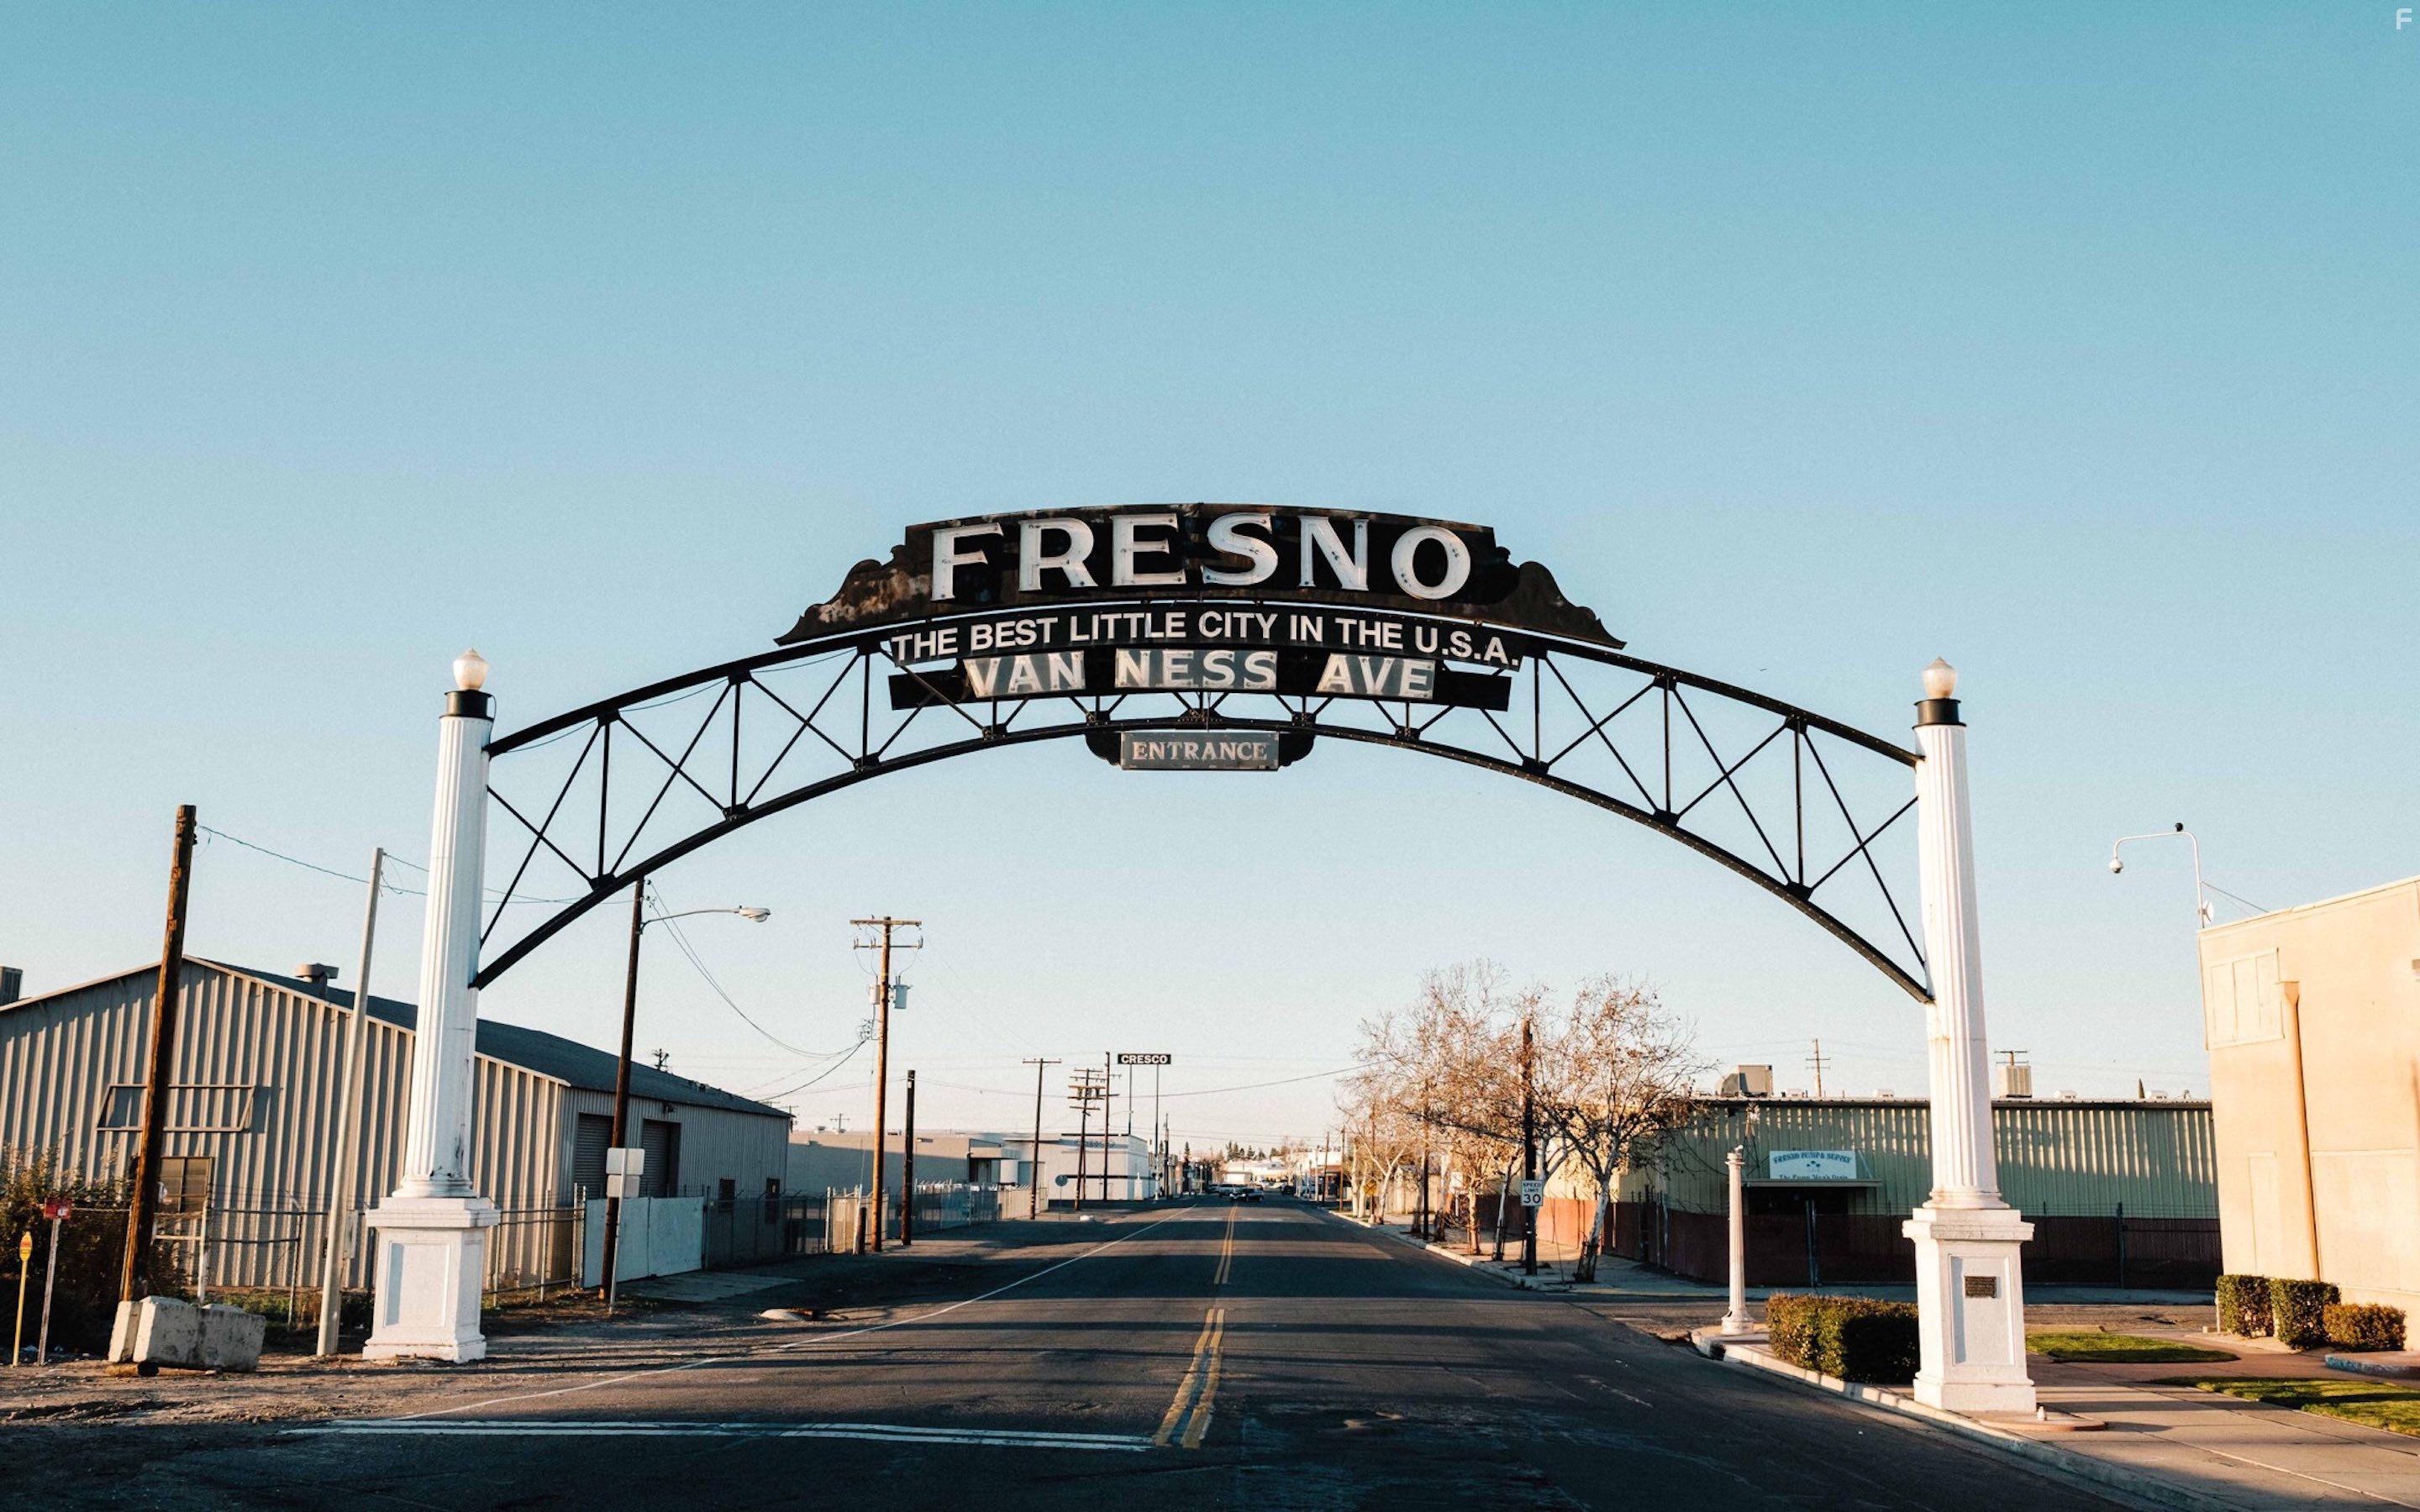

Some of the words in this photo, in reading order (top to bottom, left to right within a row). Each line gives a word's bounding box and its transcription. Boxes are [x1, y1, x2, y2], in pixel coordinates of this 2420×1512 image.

[931, 512, 1470, 601] FRESNO
[892, 627, 958, 660] THE
[971, 617, 1058, 651] BEST
[1071, 612, 1186, 641] LITTLE
[1199, 611, 1278, 638] CITY
[1290, 615, 1323, 643] IN
[1335, 617, 1403, 650] THE
[1415, 626, 1518, 666] U.S.A.
[965, 651, 1085, 697] VAN
[1115, 649, 1277, 689] NESS
[1316, 653, 1435, 699] AVE
[1132, 742, 1270, 761] ENTRANCE
[1120, 1054, 1168, 1064] CRESCO
[1523, 1194, 1541, 1204] 30
